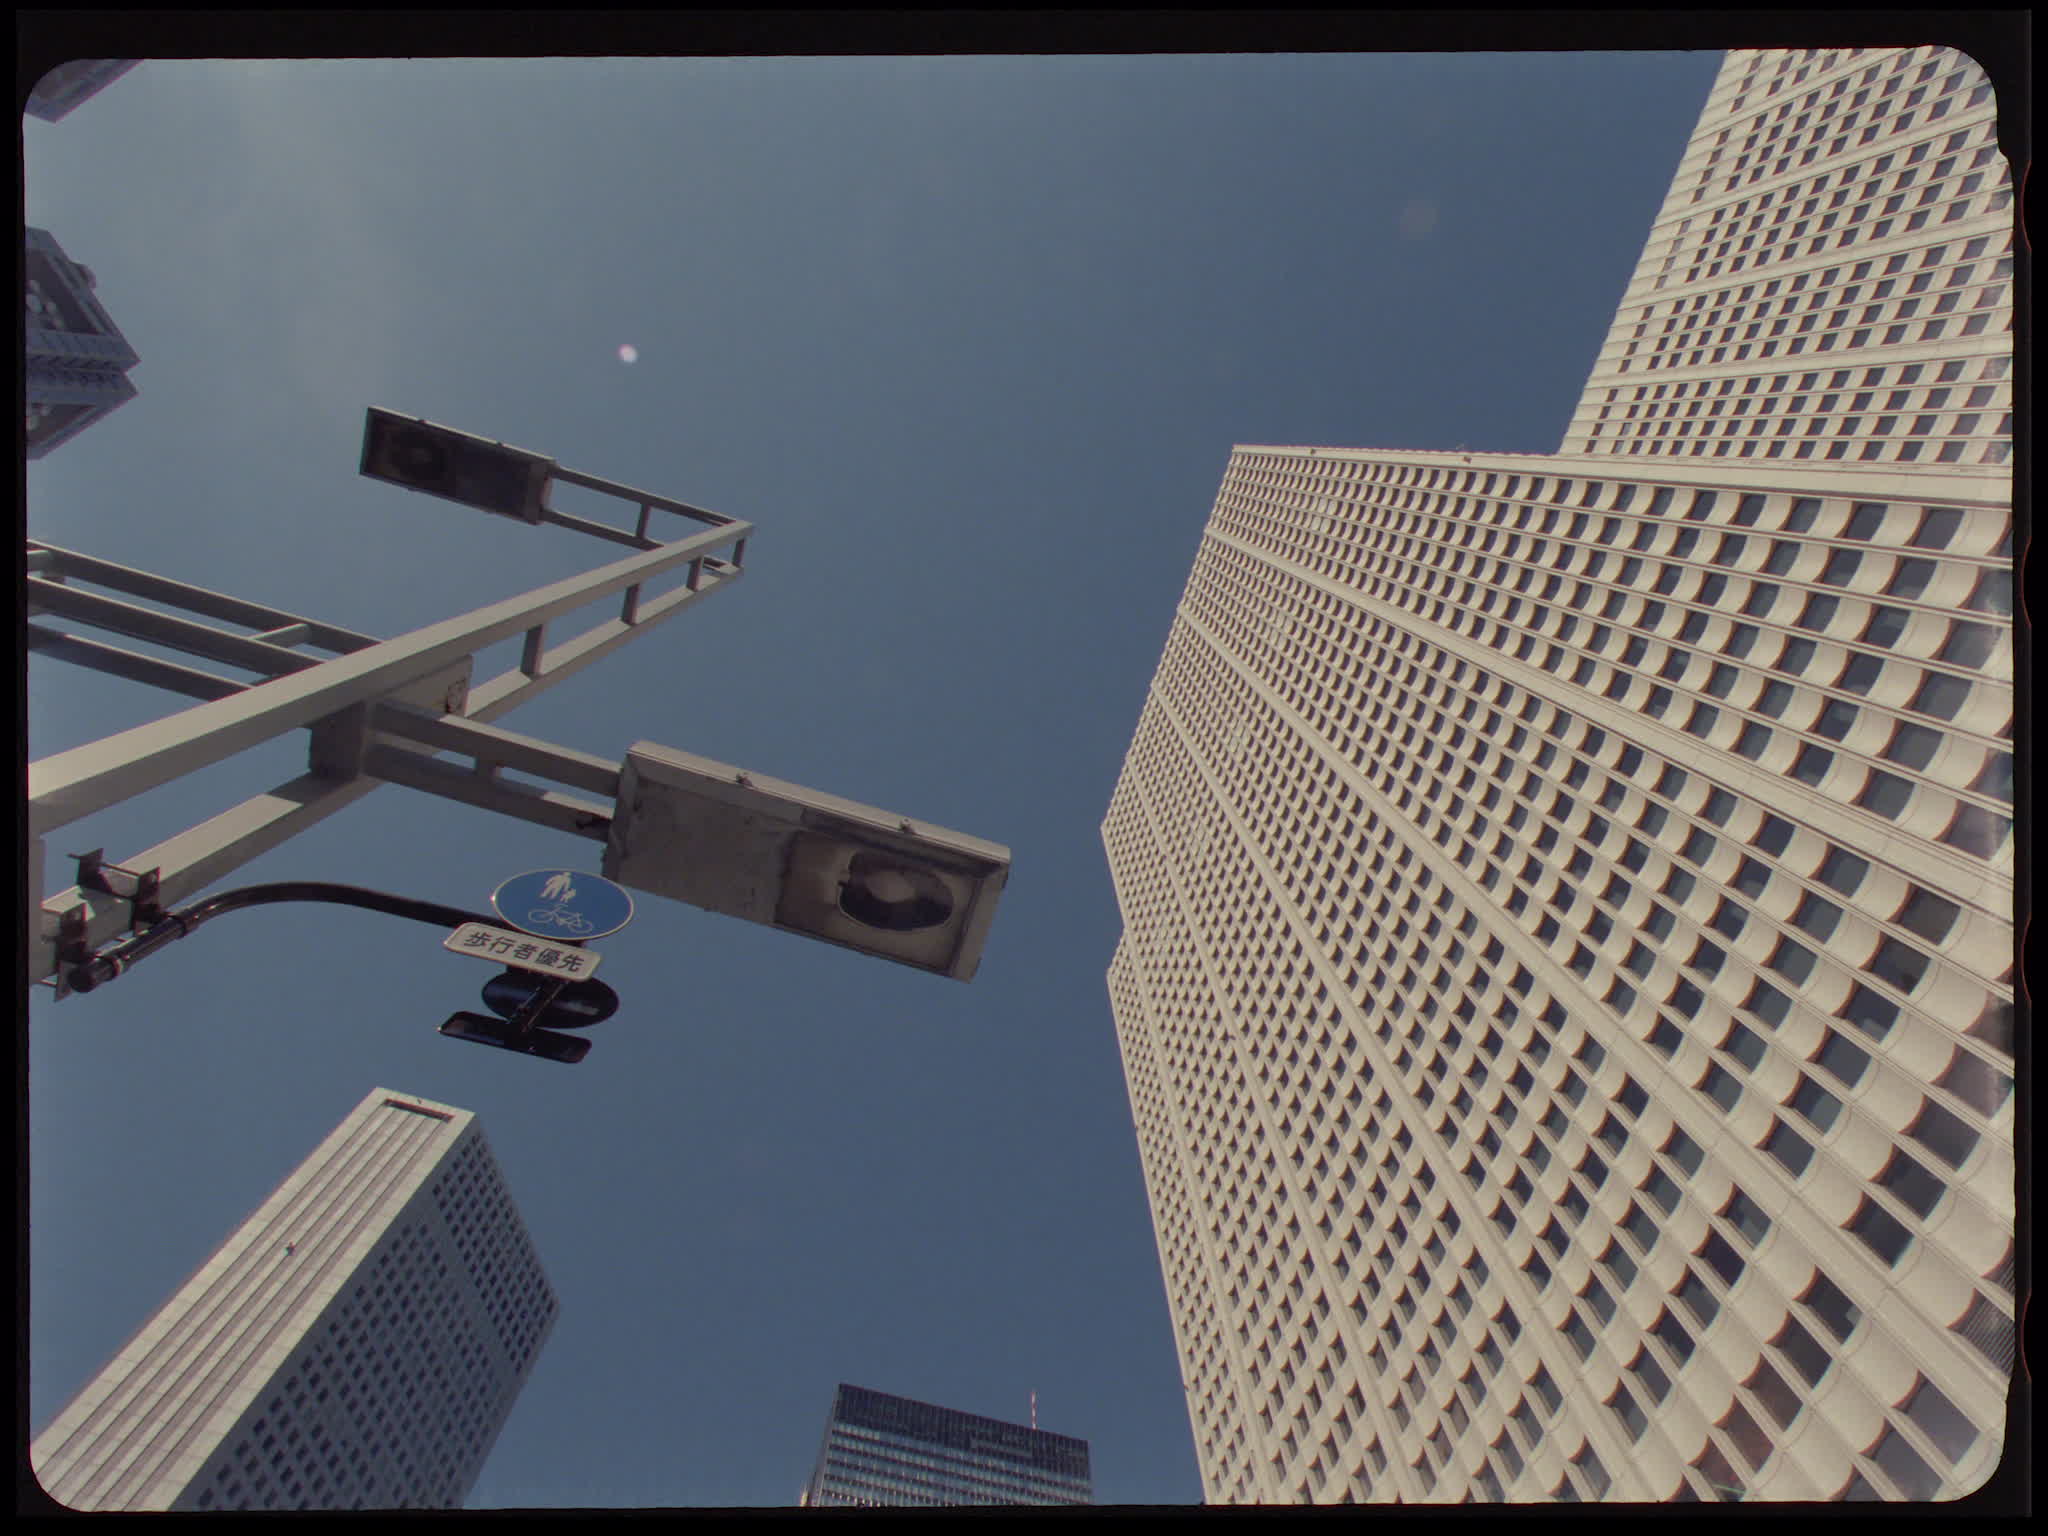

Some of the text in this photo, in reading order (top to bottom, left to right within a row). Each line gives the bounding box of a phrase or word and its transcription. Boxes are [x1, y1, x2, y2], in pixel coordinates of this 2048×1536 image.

[464, 931, 585, 972] 歩行者優先
